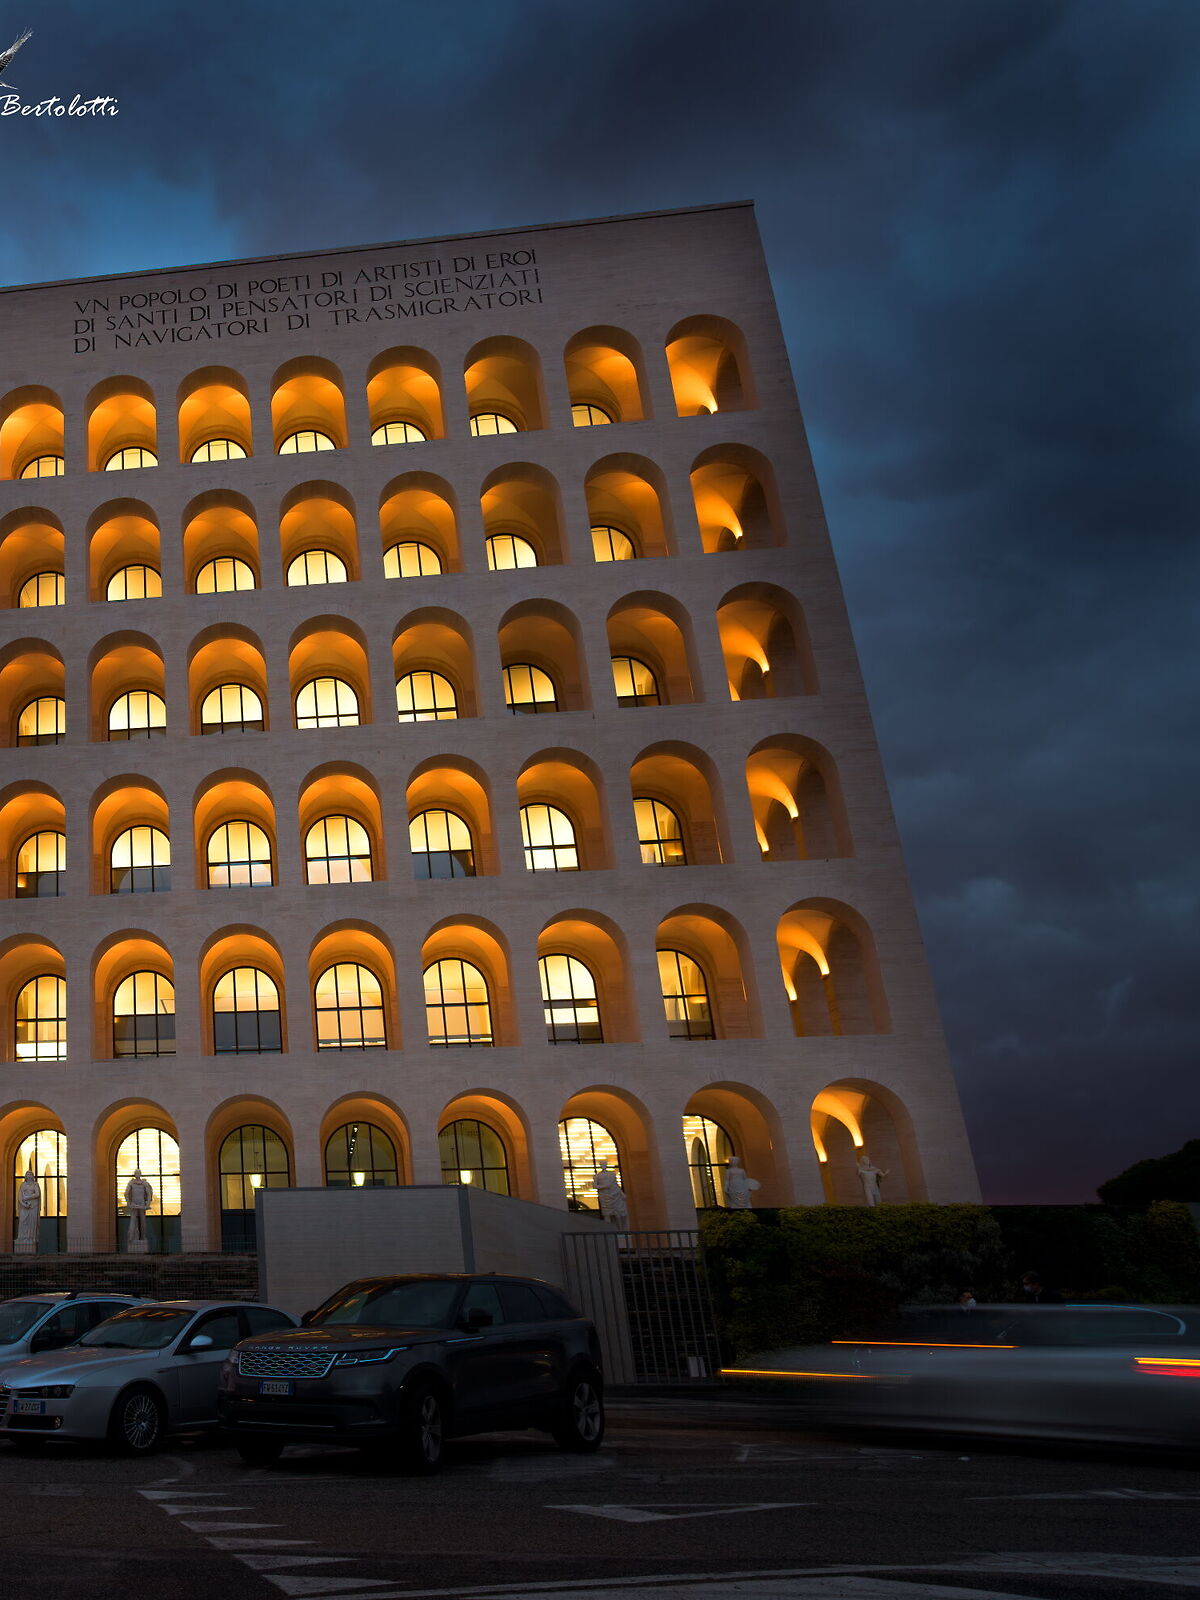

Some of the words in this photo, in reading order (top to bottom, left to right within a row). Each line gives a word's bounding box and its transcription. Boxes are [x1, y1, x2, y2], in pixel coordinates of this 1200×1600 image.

[74, 318, 95, 335] DI
[106, 308, 178, 331] SANTI
[190, 305, 211, 322] DI
[223, 288, 358, 318] PENSATORI
[370, 284, 393, 302] DI
[404, 268, 540, 298] SCIENZIATI
[75, 297, 110, 314] VN
[119, 287, 207, 311] POPOLO
[217, 282, 238, 300] DI
[248, 274, 311, 296] POETI
[322, 271, 343, 288] DI
[354, 259, 442, 285] ARTISTI
[453, 256, 476, 273] DI
[486, 249, 537, 270] EROI
[74, 337, 96, 354] DI
[115, 317, 268, 349] NAVIGATORI
[287, 313, 311, 331] DI
[328, 288, 544, 326] TRASMIGRATORI
